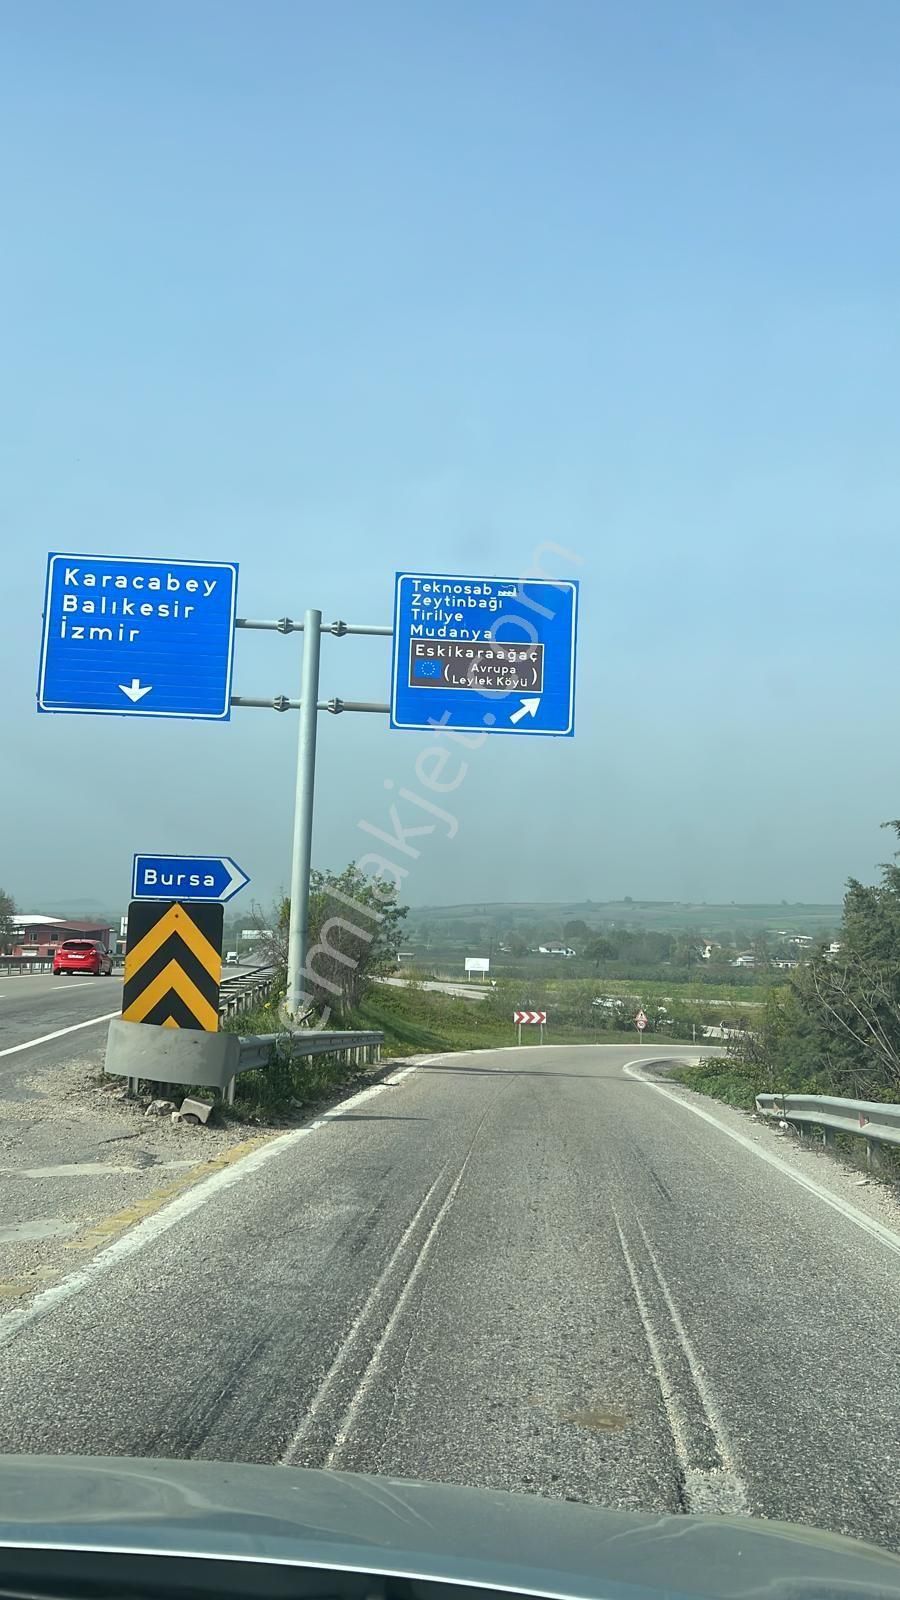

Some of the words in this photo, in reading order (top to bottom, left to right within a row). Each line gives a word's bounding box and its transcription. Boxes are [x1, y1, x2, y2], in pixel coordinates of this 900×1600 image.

[64, 568, 217, 597] Karacabey
[411, 580, 492, 596] Teknosab
[63, 594, 195, 618] Balıkesir
[411, 594, 503, 611] Zeytinbağı
[411, 608, 464, 625] Tirilye
[60, 615, 140, 642] İzmir
[410, 624, 492, 641] Mudanya
[415, 644, 538, 663] Eskikaraağaç
[471, 663, 516, 675] Avrupa
[143, 869, 215, 887] Bursa
